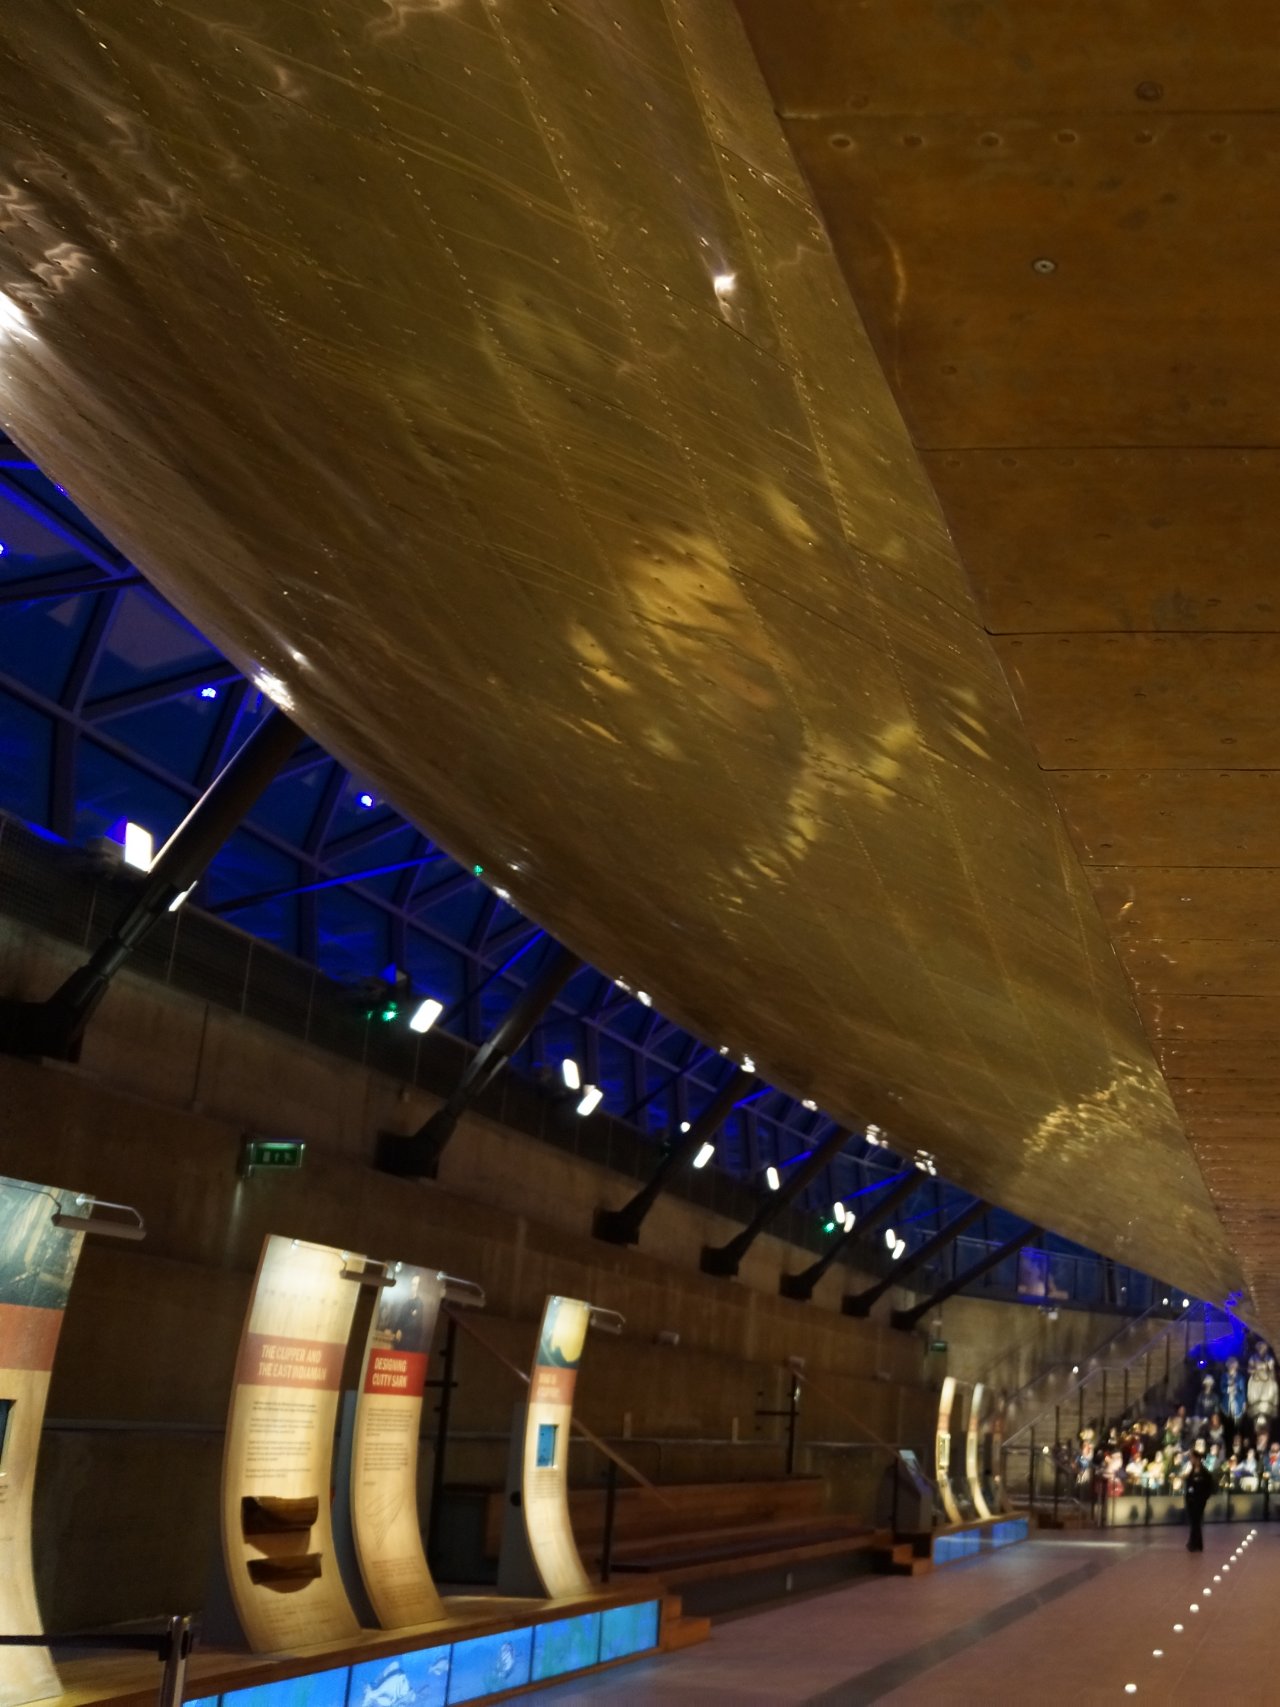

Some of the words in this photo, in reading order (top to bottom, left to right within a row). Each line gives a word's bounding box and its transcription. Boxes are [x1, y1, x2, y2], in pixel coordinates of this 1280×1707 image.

[262, 1344, 277, 1359] THE
[276, 1346, 306, 1362] CLIPPER
[306, 1348, 322, 1364] AND
[258, 1361, 273, 1377] THE
[272, 1363, 292, 1379] EAST
[374, 1357, 407, 1373] DESIGNING
[372, 1373, 392, 1387] CUTTY
